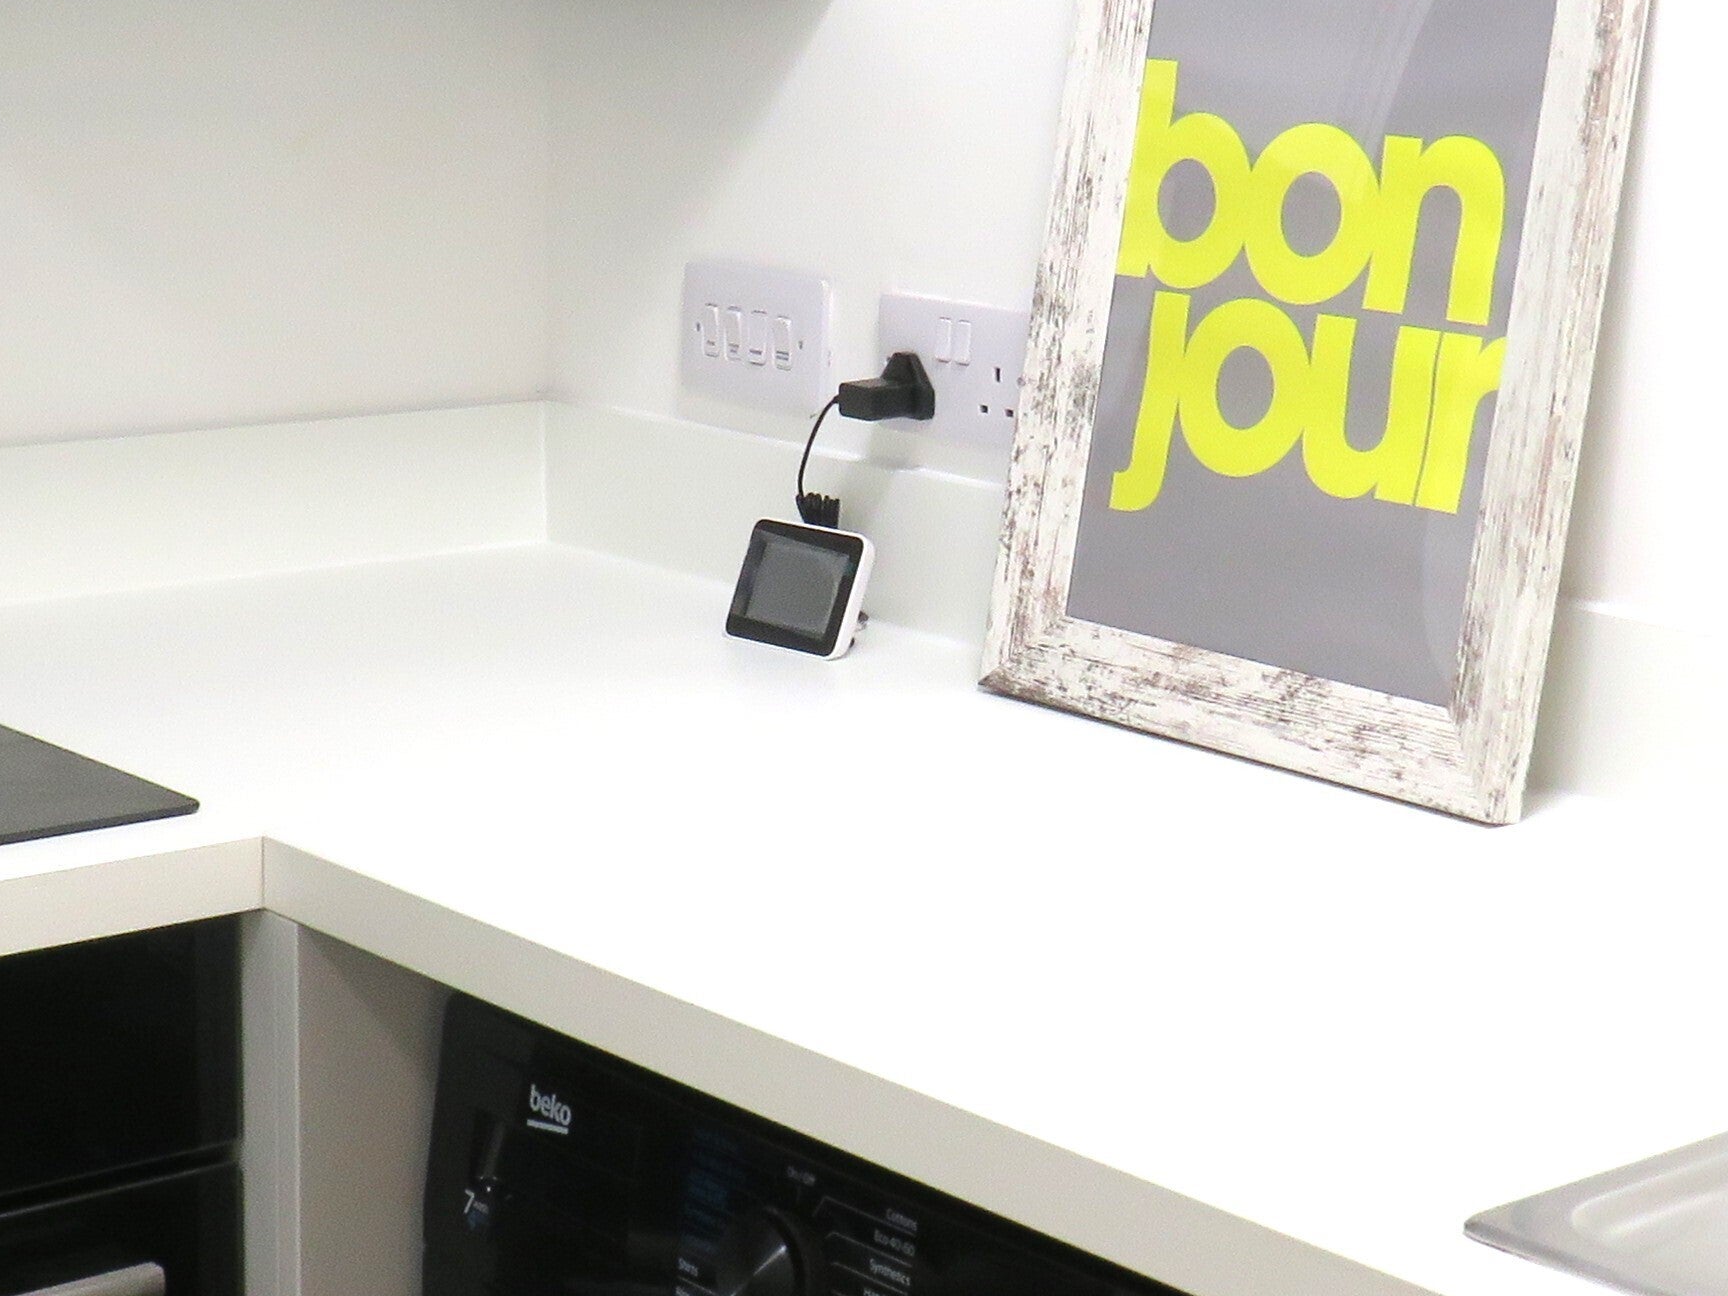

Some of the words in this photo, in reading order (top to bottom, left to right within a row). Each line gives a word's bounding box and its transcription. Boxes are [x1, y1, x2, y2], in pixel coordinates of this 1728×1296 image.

[1115, 58, 1505, 327] bon
[1110, 292, 1507, 515] jour
[528, 1083, 573, 1127] beko
[869, 1257, 911, 1287] Synthetics
